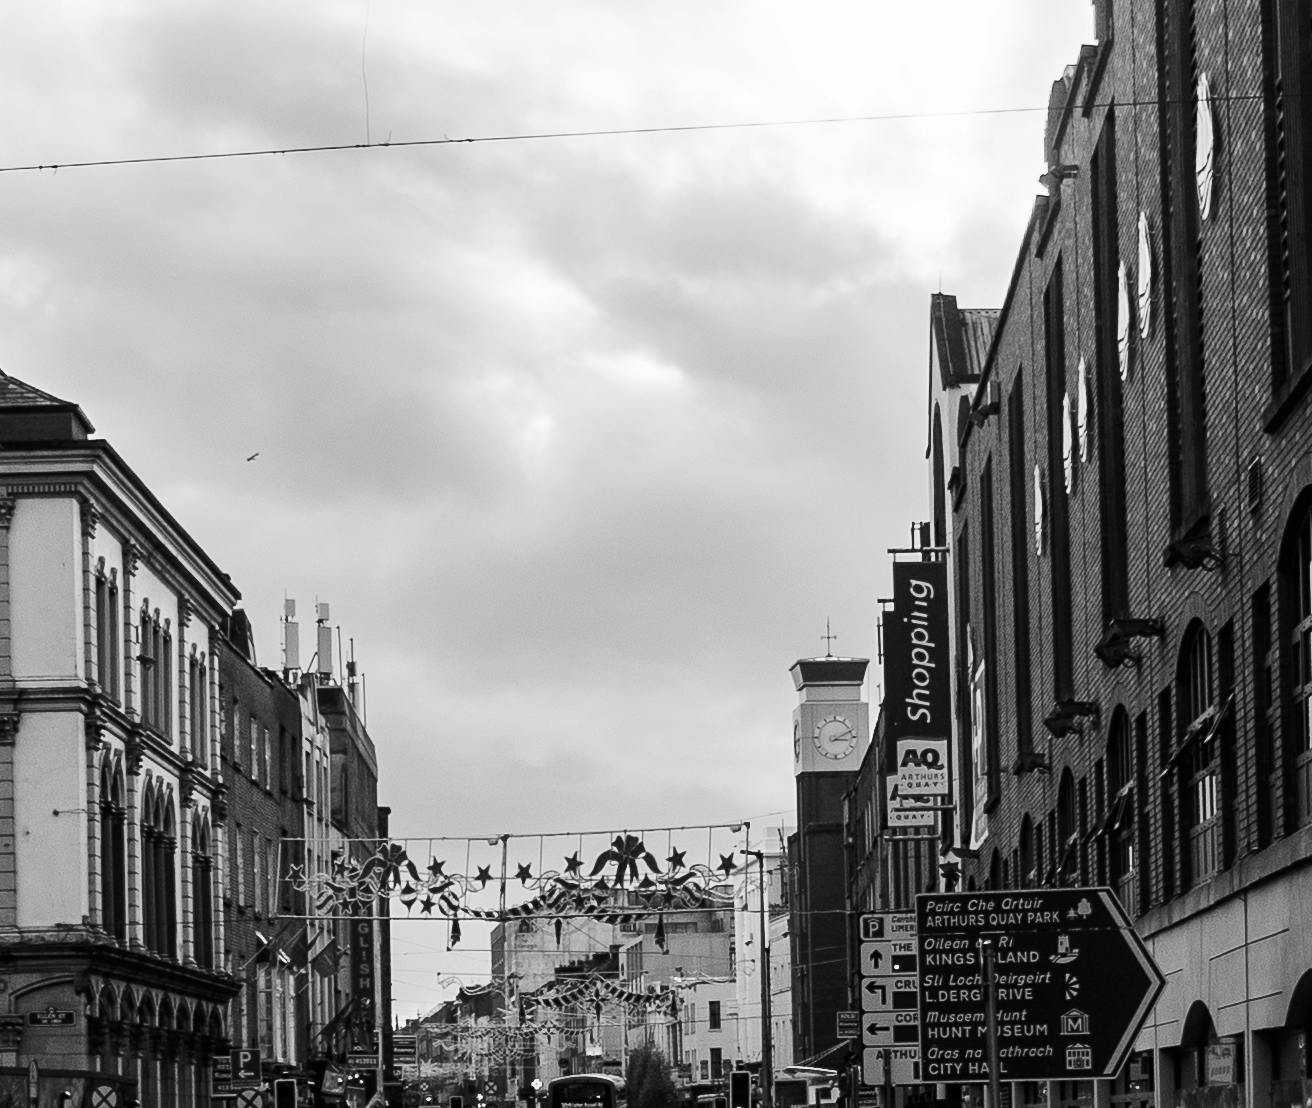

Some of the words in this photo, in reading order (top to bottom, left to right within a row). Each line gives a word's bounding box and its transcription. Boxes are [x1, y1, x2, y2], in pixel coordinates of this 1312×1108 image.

[905, 579, 936, 724] Shopping
[900, 748, 944, 771] AQ
[901, 773, 944, 781] ARTHURS
[907, 781, 938, 789] QUAY
[925, 914, 986, 927] ARTHURS
[989, 912, 1023, 926] QUAY
[1027, 911, 1060, 924] PARK
[892, 943, 912, 952] THE
[925, 953, 975, 966] KINGS
[993, 951, 1040, 965] LAND
[948, 973, 983, 986] Loch
[925, 989, 981, 1003] L.DERG
[998, 988, 1034, 1000] RIVE
[926, 1011, 985, 1024] Musaem
[927, 1026, 972, 1039] HUNT
[876, 1049, 917, 1060] ATHU
[965, 1049, 982, 1060] na
[999, 1045, 1054, 1058] athrach
[239, 1052, 252, 1068] P
[928, 1062, 964, 1075] CITY
[968, 1061, 1009, 1075] HAL
